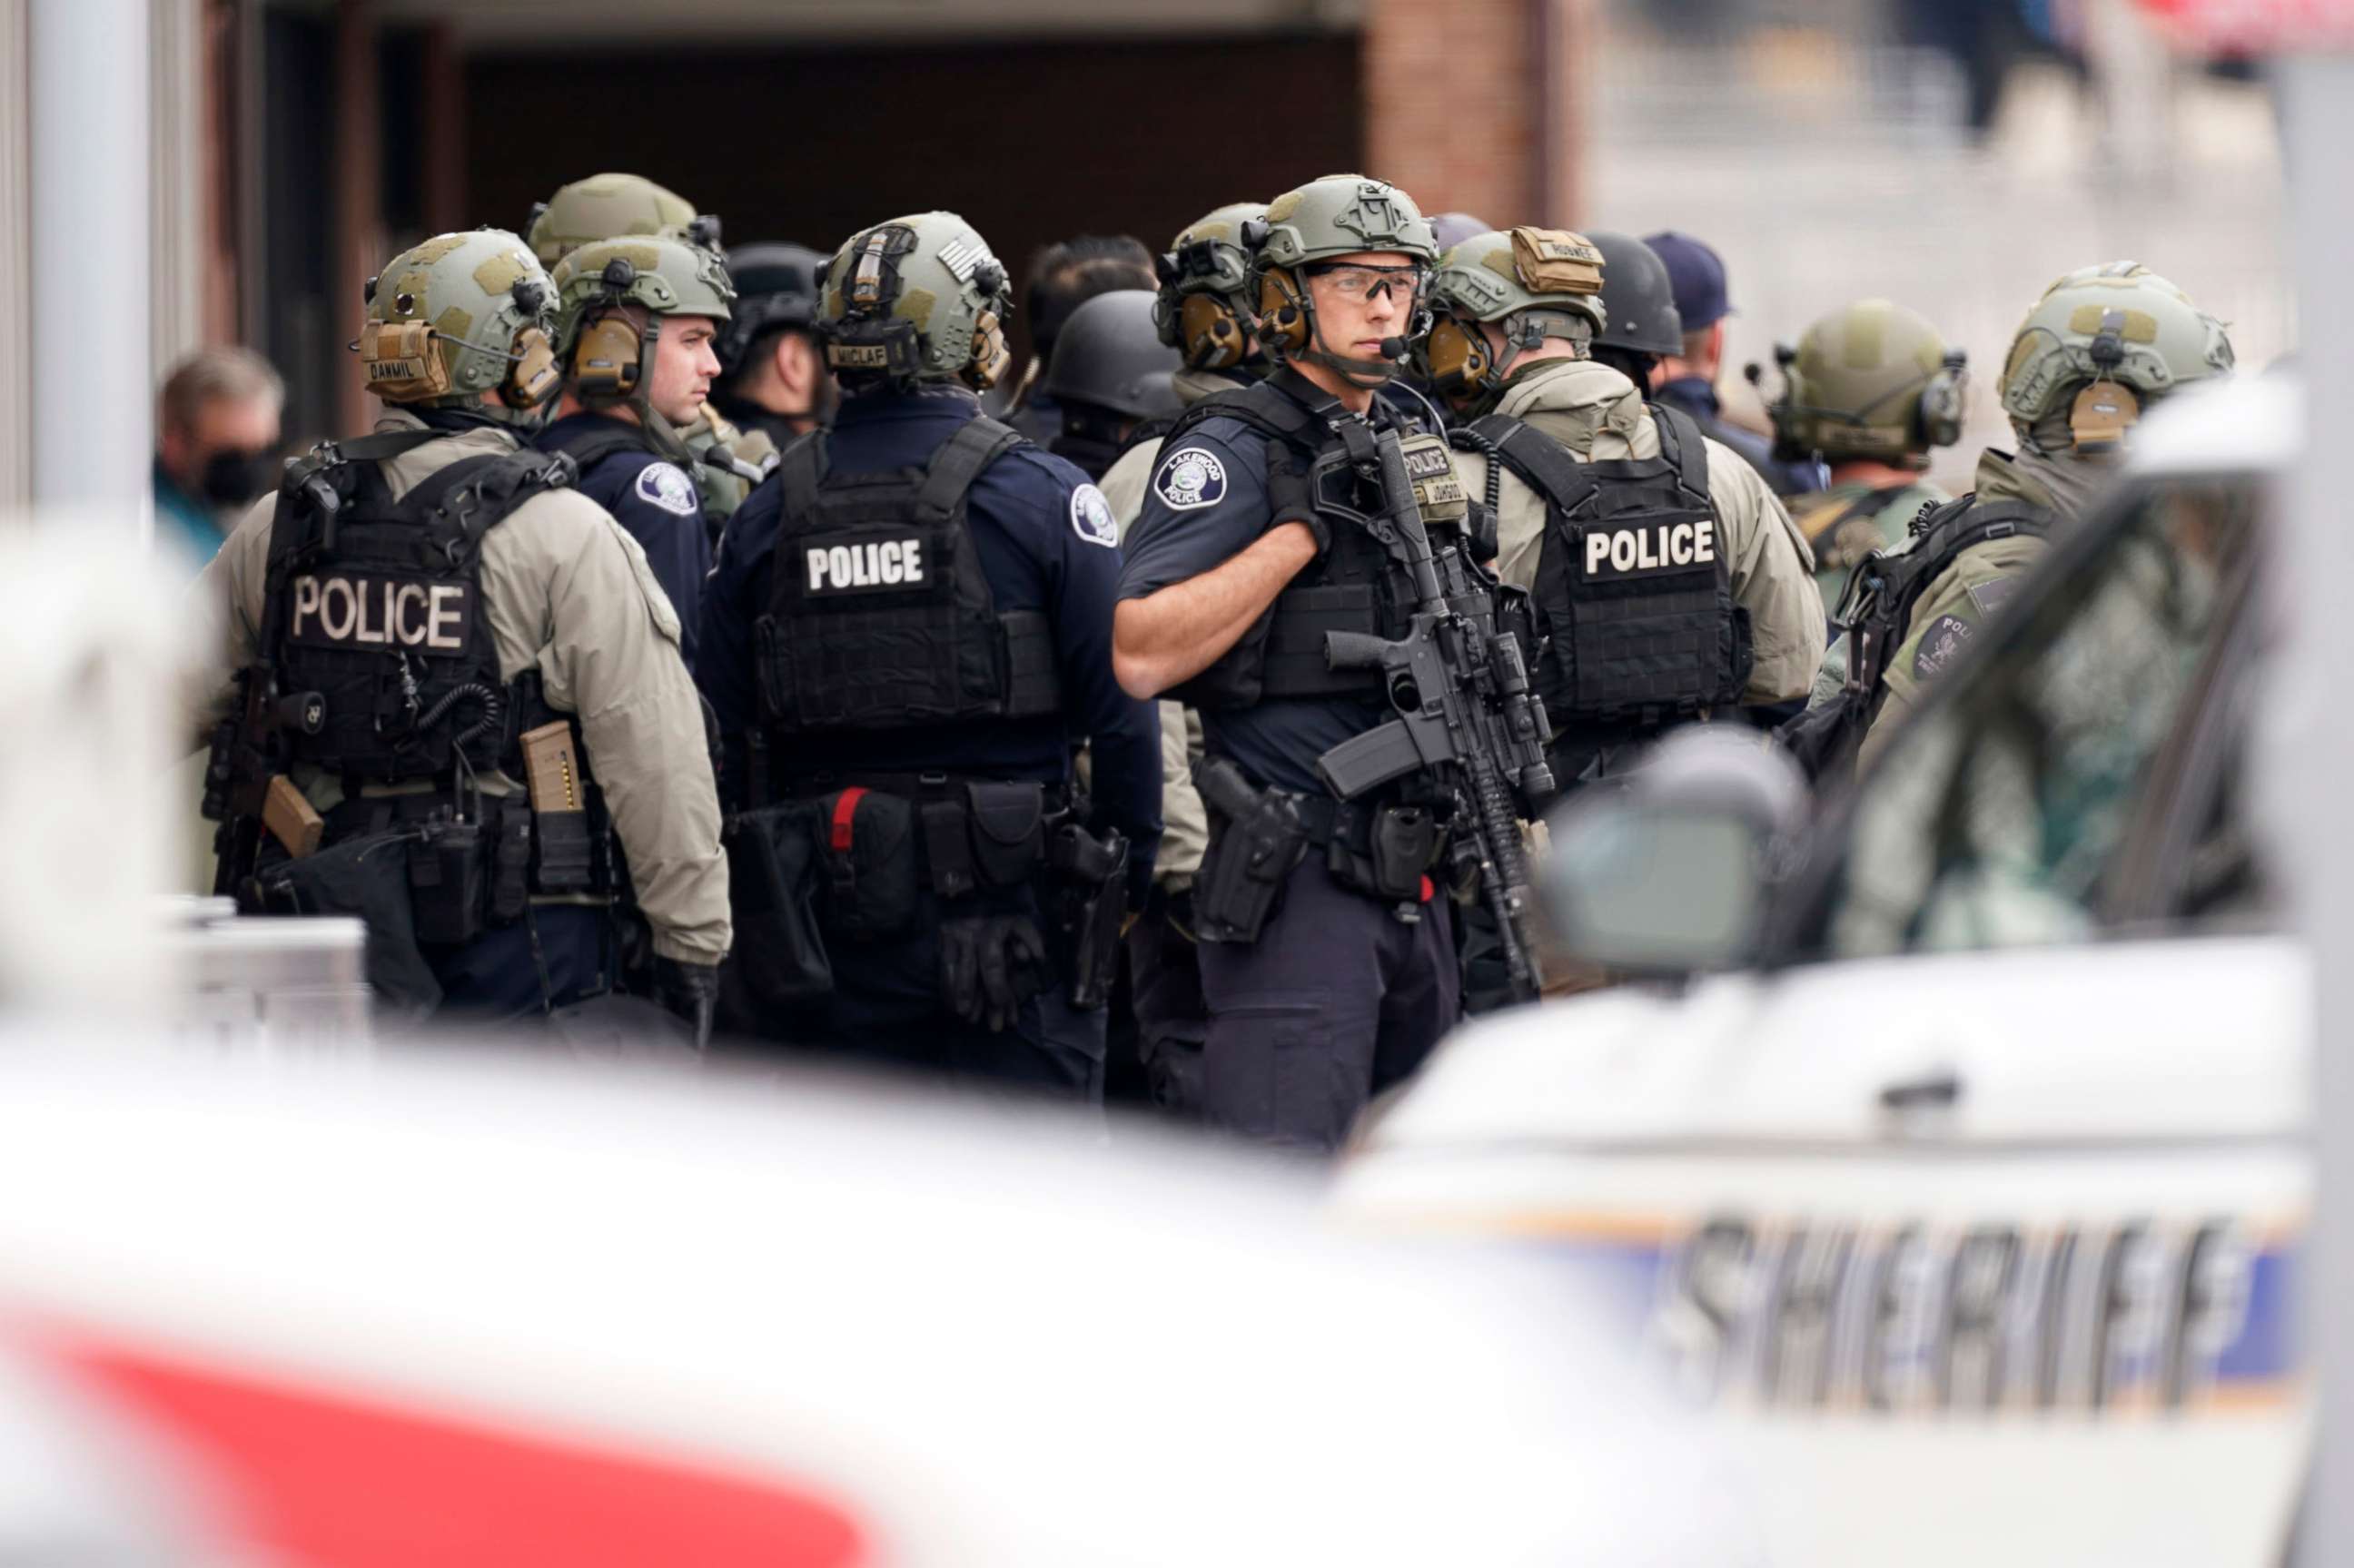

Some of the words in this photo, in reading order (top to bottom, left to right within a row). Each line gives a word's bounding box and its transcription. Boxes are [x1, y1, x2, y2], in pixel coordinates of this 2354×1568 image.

[1169, 453, 1221, 481] LAKEWOOD
[1403, 449, 1448, 473] POLICE
[1164, 485, 1202, 503] POLICE
[806, 539, 923, 589] POLICE
[1587, 520, 1714, 574] POLICE
[293, 576, 464, 647] POLICE
[1669, 1219, 2248, 1413] SHERIFF
